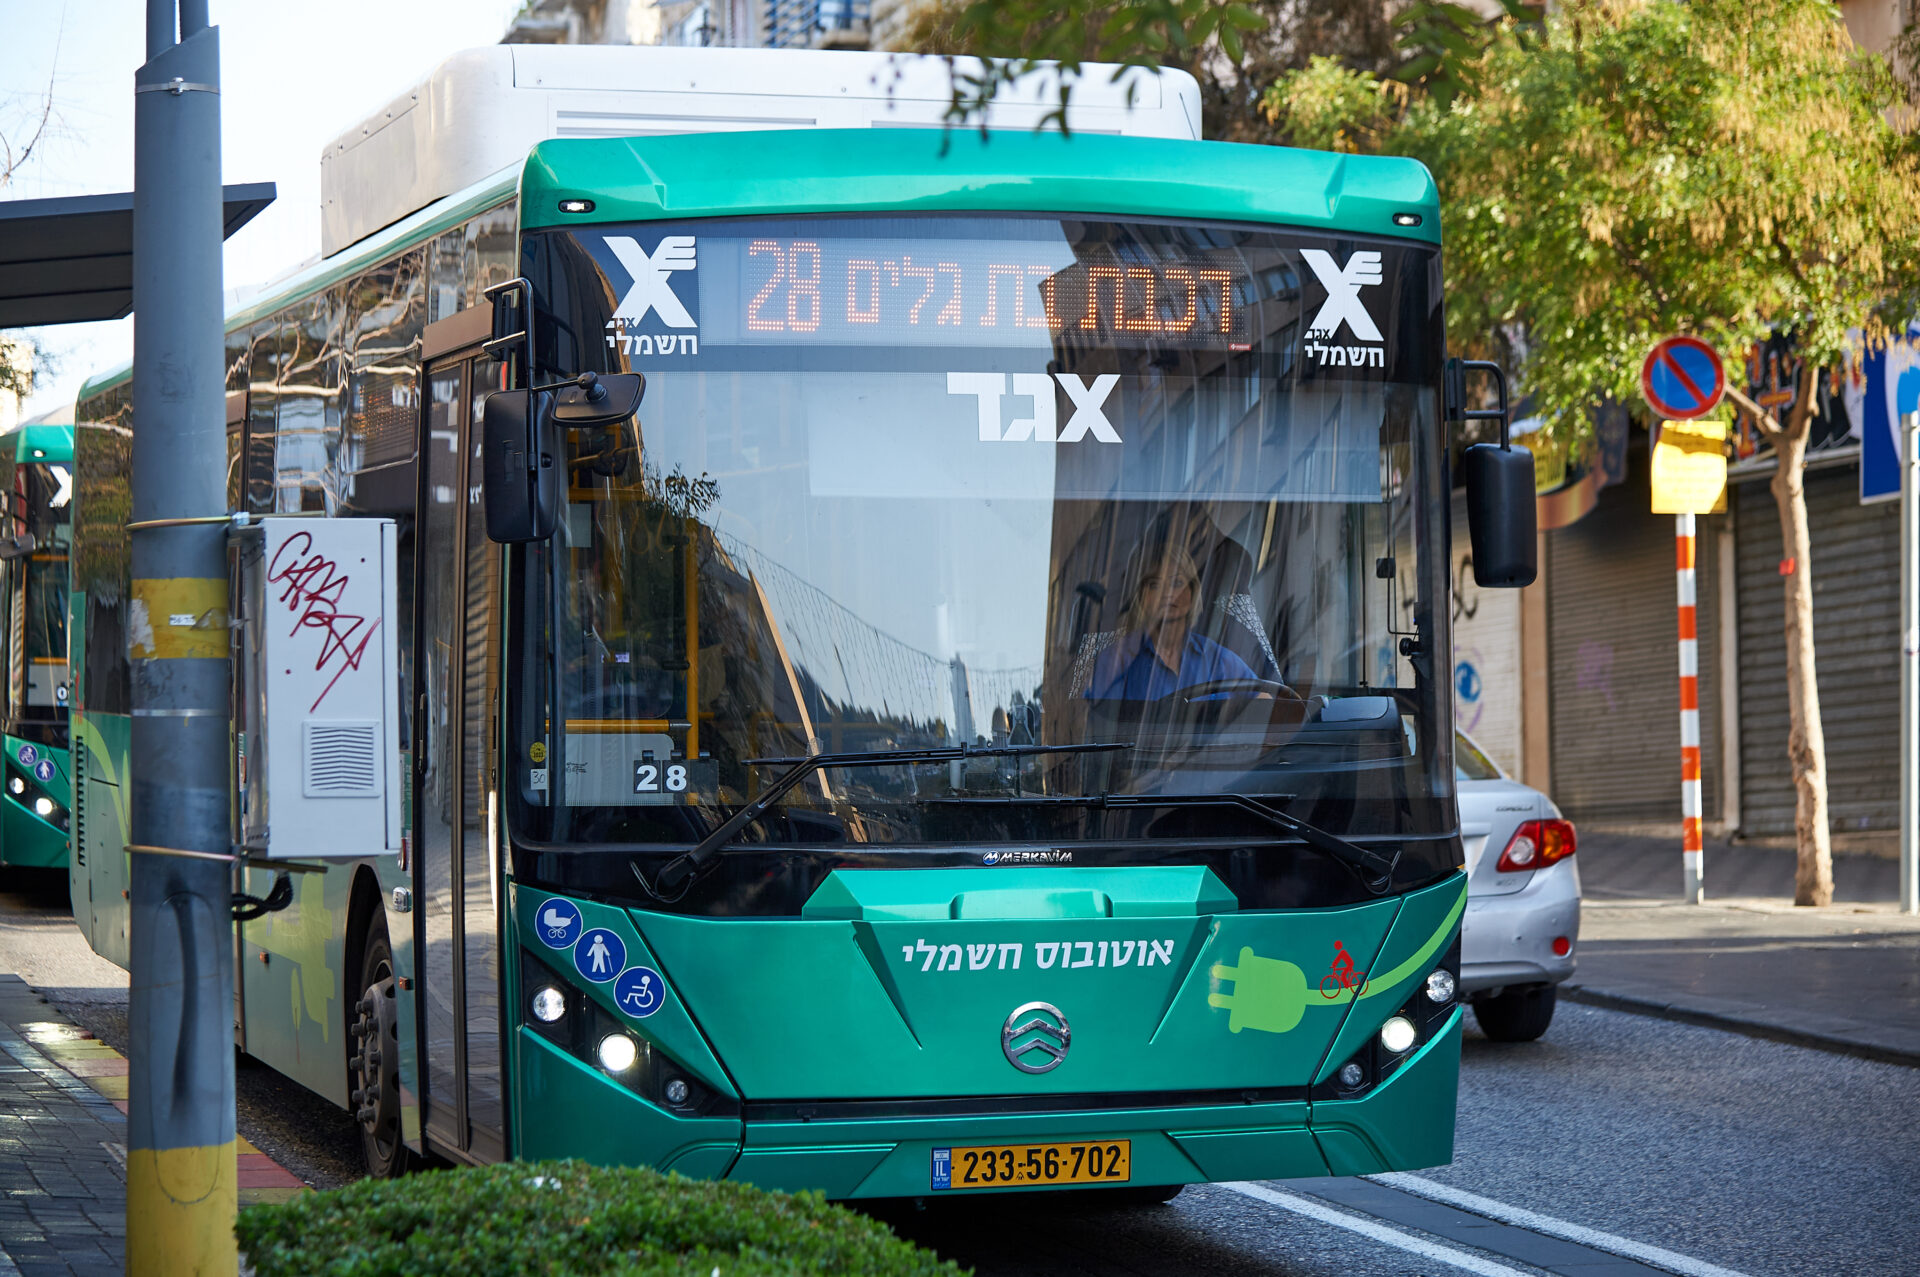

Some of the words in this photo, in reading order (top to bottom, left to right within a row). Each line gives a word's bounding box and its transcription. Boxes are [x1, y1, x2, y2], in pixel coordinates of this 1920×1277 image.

[749, 240, 821, 332] 28
[847, 256, 962, 326] גלים
[980, 264, 1062, 328] בת
[1080, 266, 1231, 333] רכבת
[605, 330, 698, 355] חשמלי
[1304, 340, 1385, 368] חשמלי
[946, 371, 1123, 443] אגד
[636, 764, 687, 791] 28
[902, 938, 1023, 972] חשמלי
[1034, 939, 1175, 969] אוטובוס
[935, 1161, 947, 1177] IL
